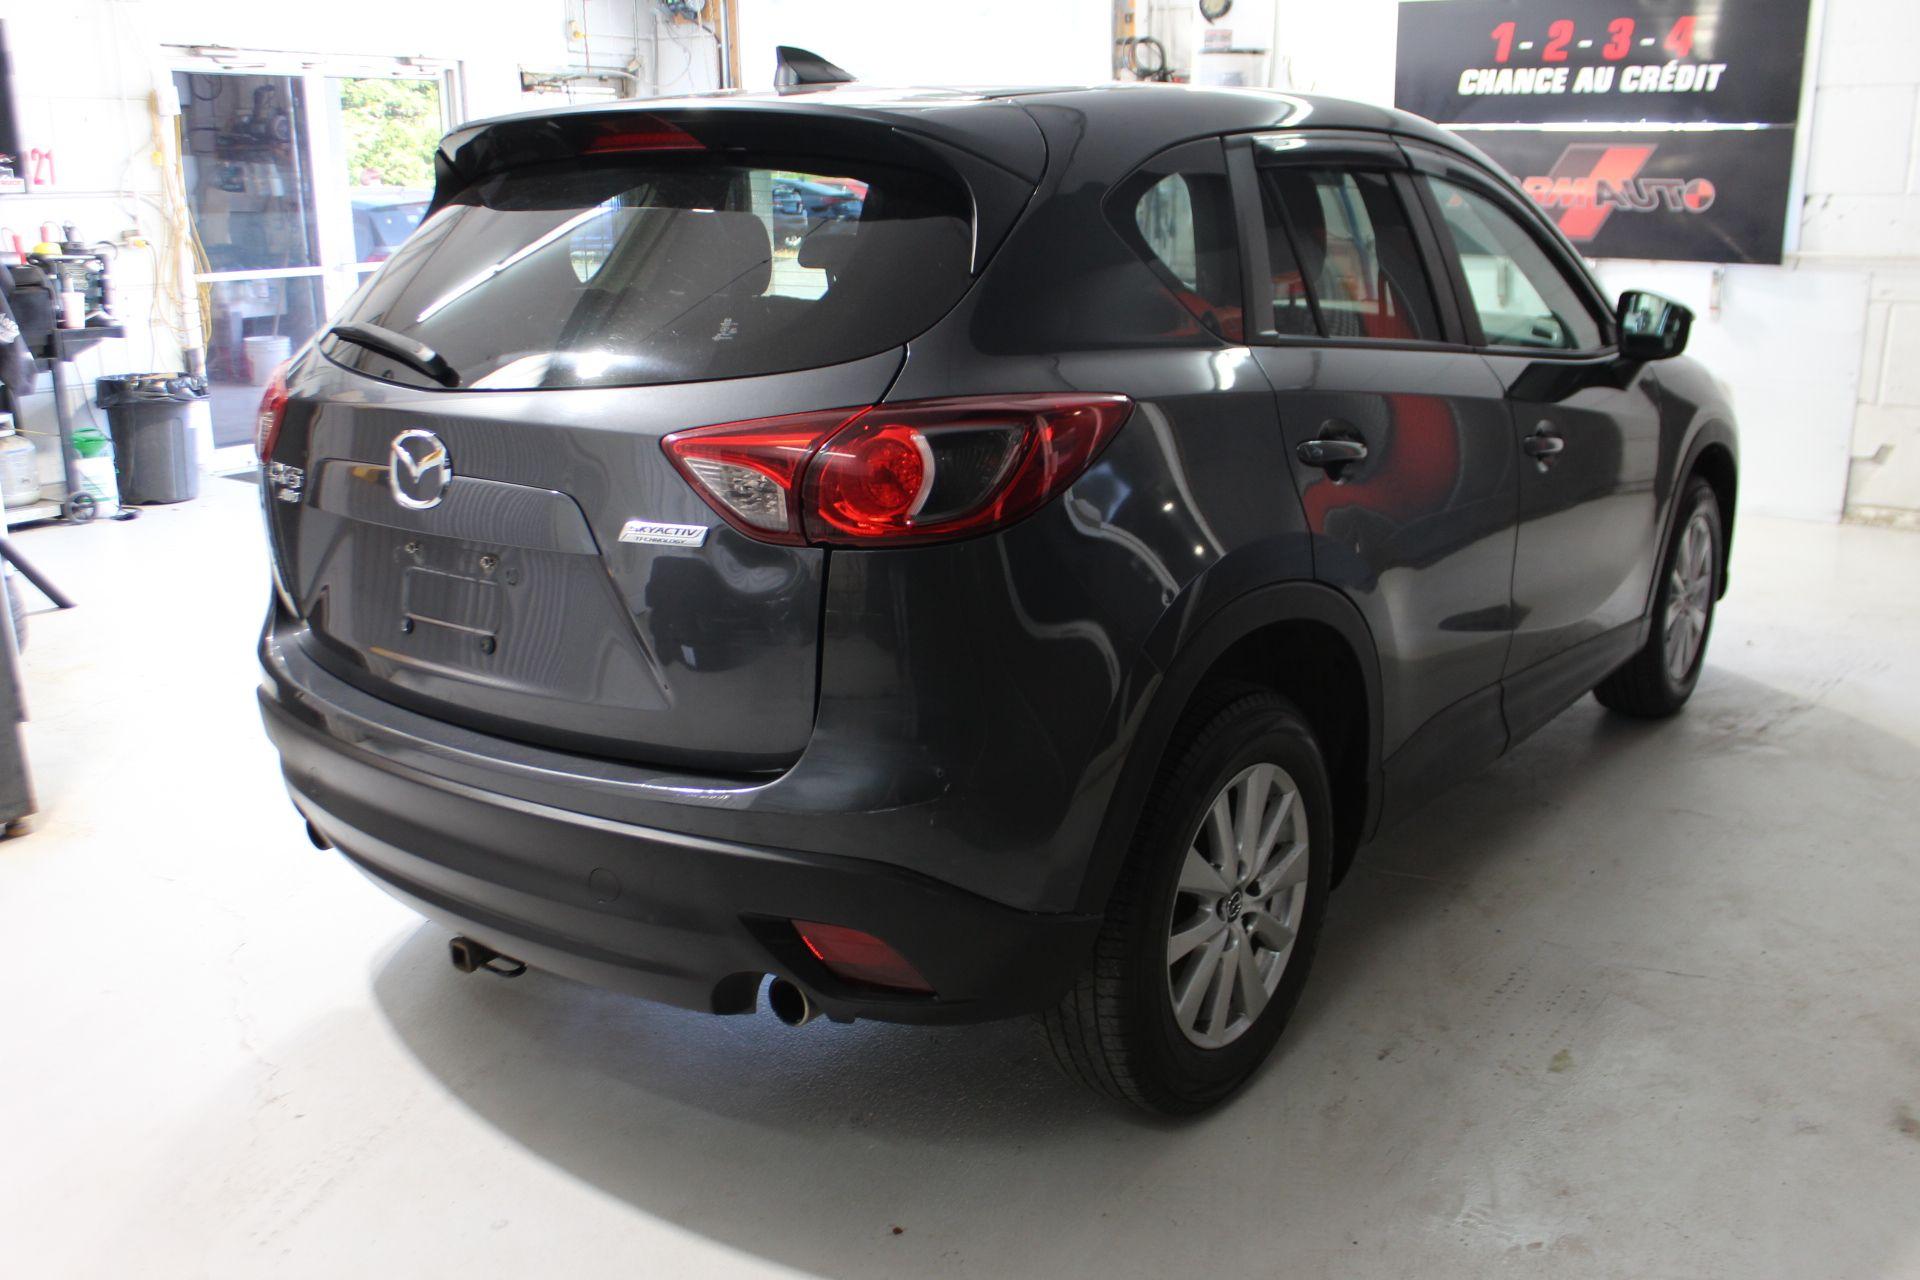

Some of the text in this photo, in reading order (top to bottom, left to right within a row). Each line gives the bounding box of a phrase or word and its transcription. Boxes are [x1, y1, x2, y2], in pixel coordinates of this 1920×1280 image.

[1458, 59, 1727, 95] CHANCE AU CRÉDIT
